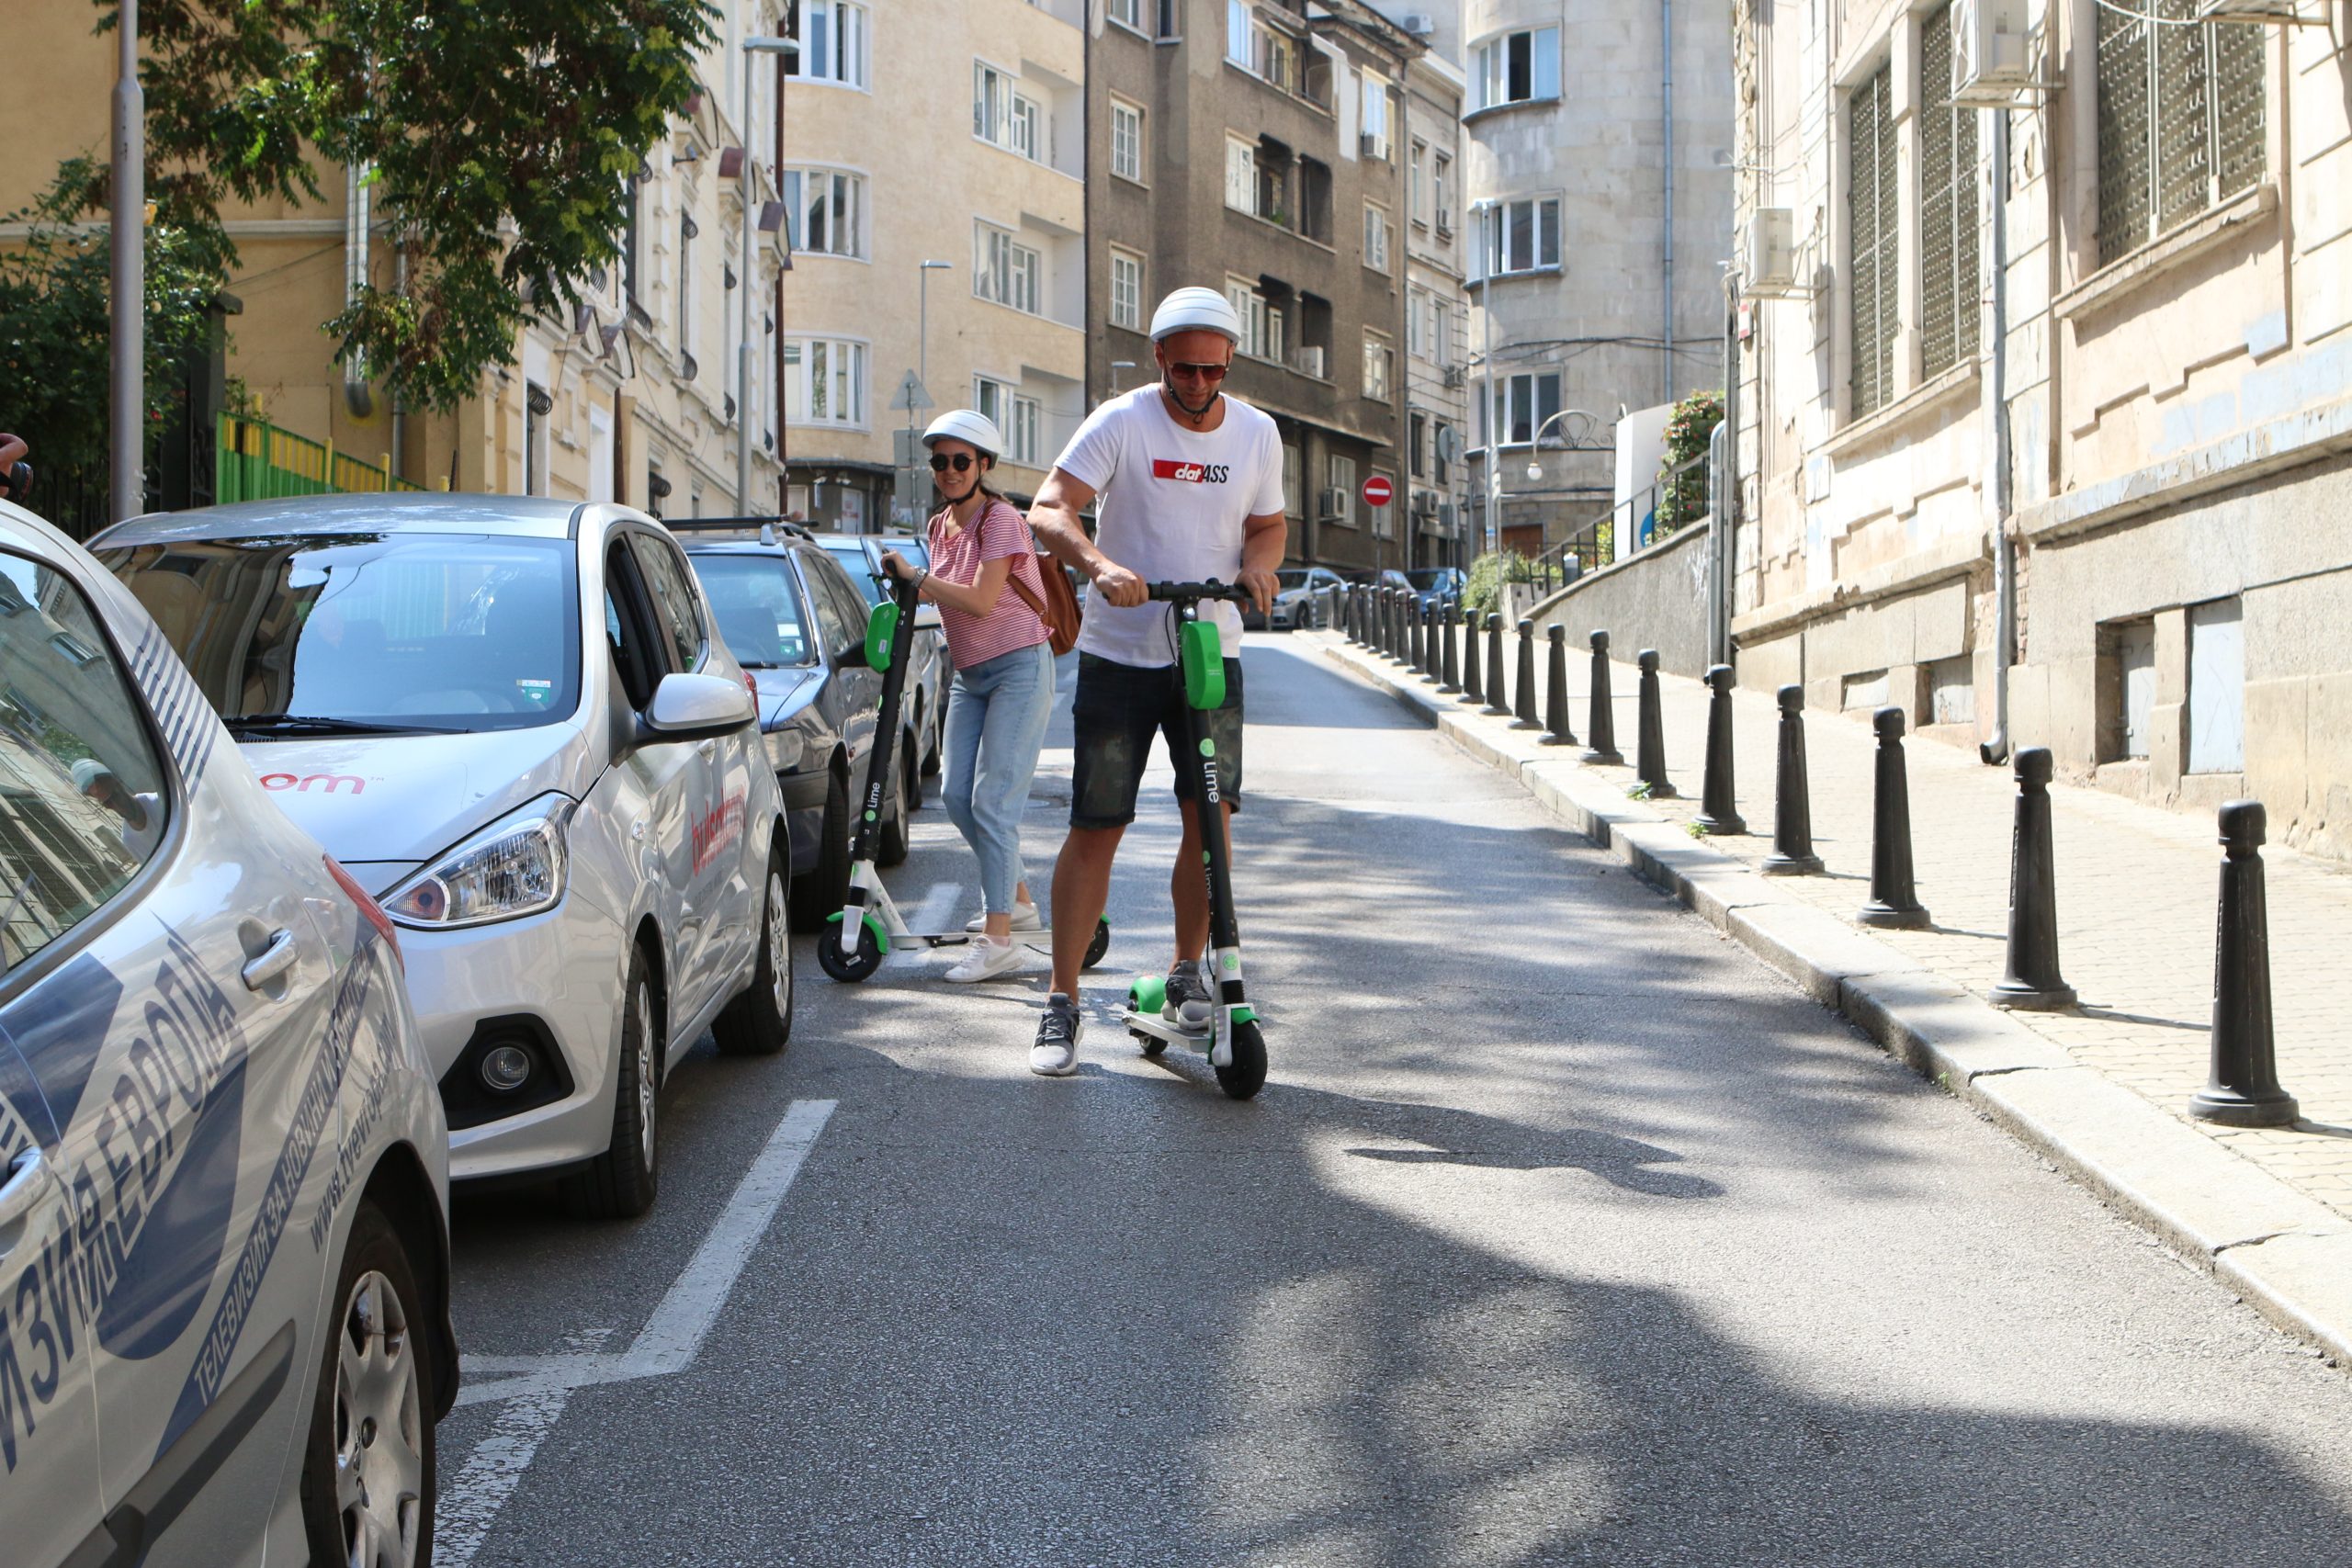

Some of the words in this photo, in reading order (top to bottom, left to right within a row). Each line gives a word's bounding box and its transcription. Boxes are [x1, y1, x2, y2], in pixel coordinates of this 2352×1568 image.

[867, 781, 881, 808] Lime
[1204, 761, 1219, 804] Lime
[94, 908, 241, 1261] ЕВРОПА
[194, 1214, 270, 1407] ТЕЛЕВИЗИЯ
[266, 1180, 288, 1237] ЗА
[281, 1071, 328, 1199] НОВИНИ
